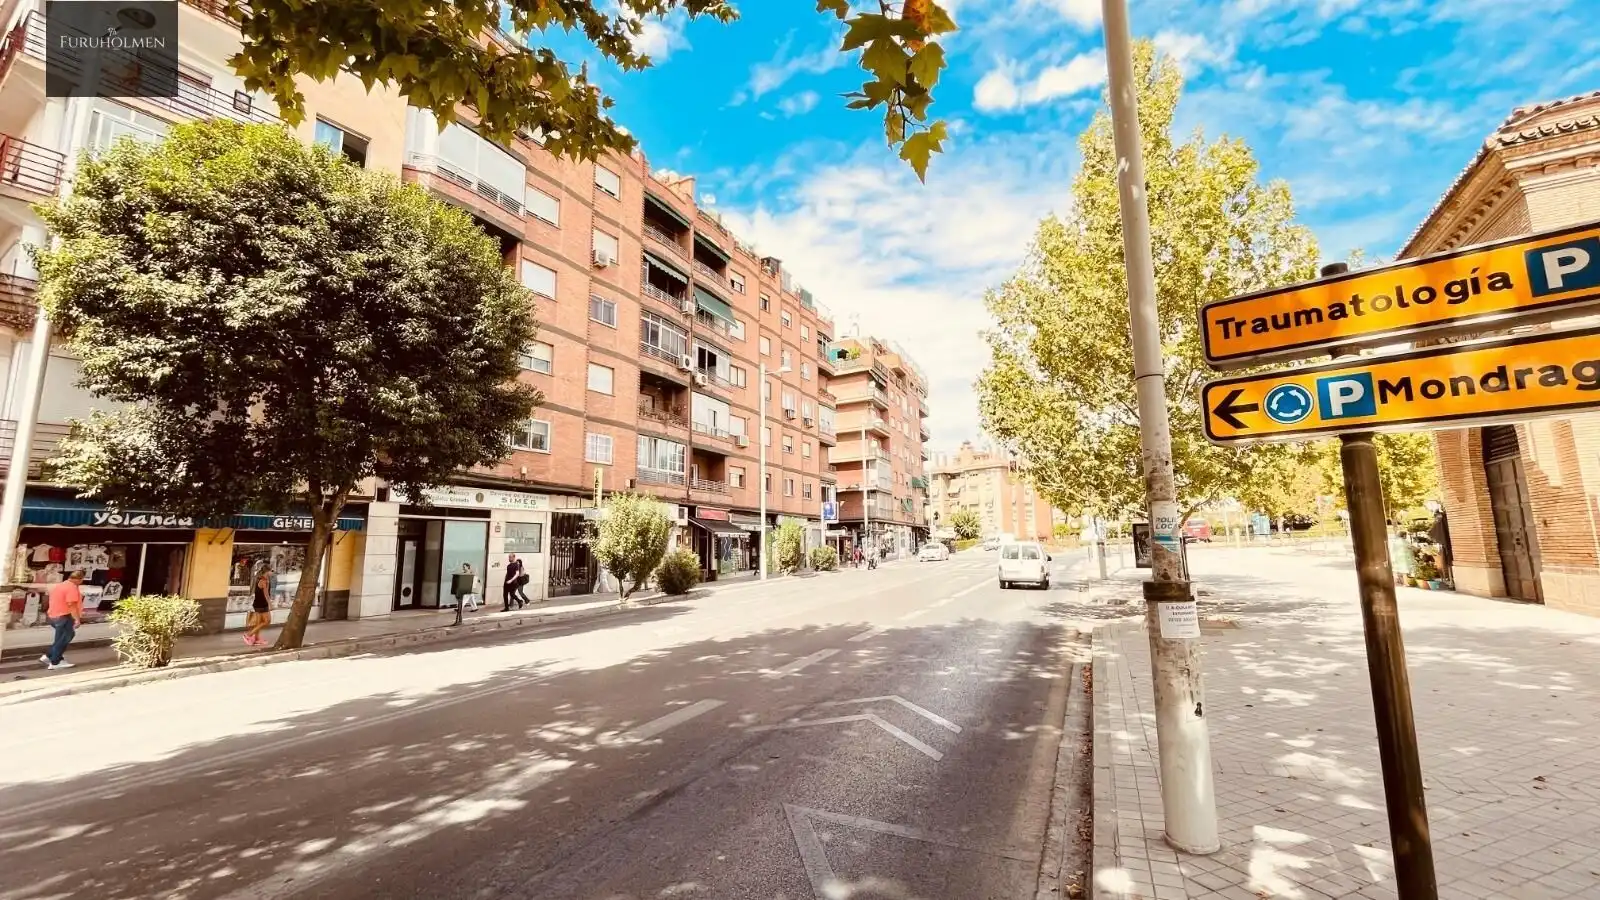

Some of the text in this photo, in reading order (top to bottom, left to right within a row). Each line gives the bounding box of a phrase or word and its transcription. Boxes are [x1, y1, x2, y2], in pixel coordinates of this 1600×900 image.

[1214, 246, 1590, 340] Traumatología P
[1327, 358, 1600, 416] P Mondrag
[501, 497, 537, 506] SIMEG
